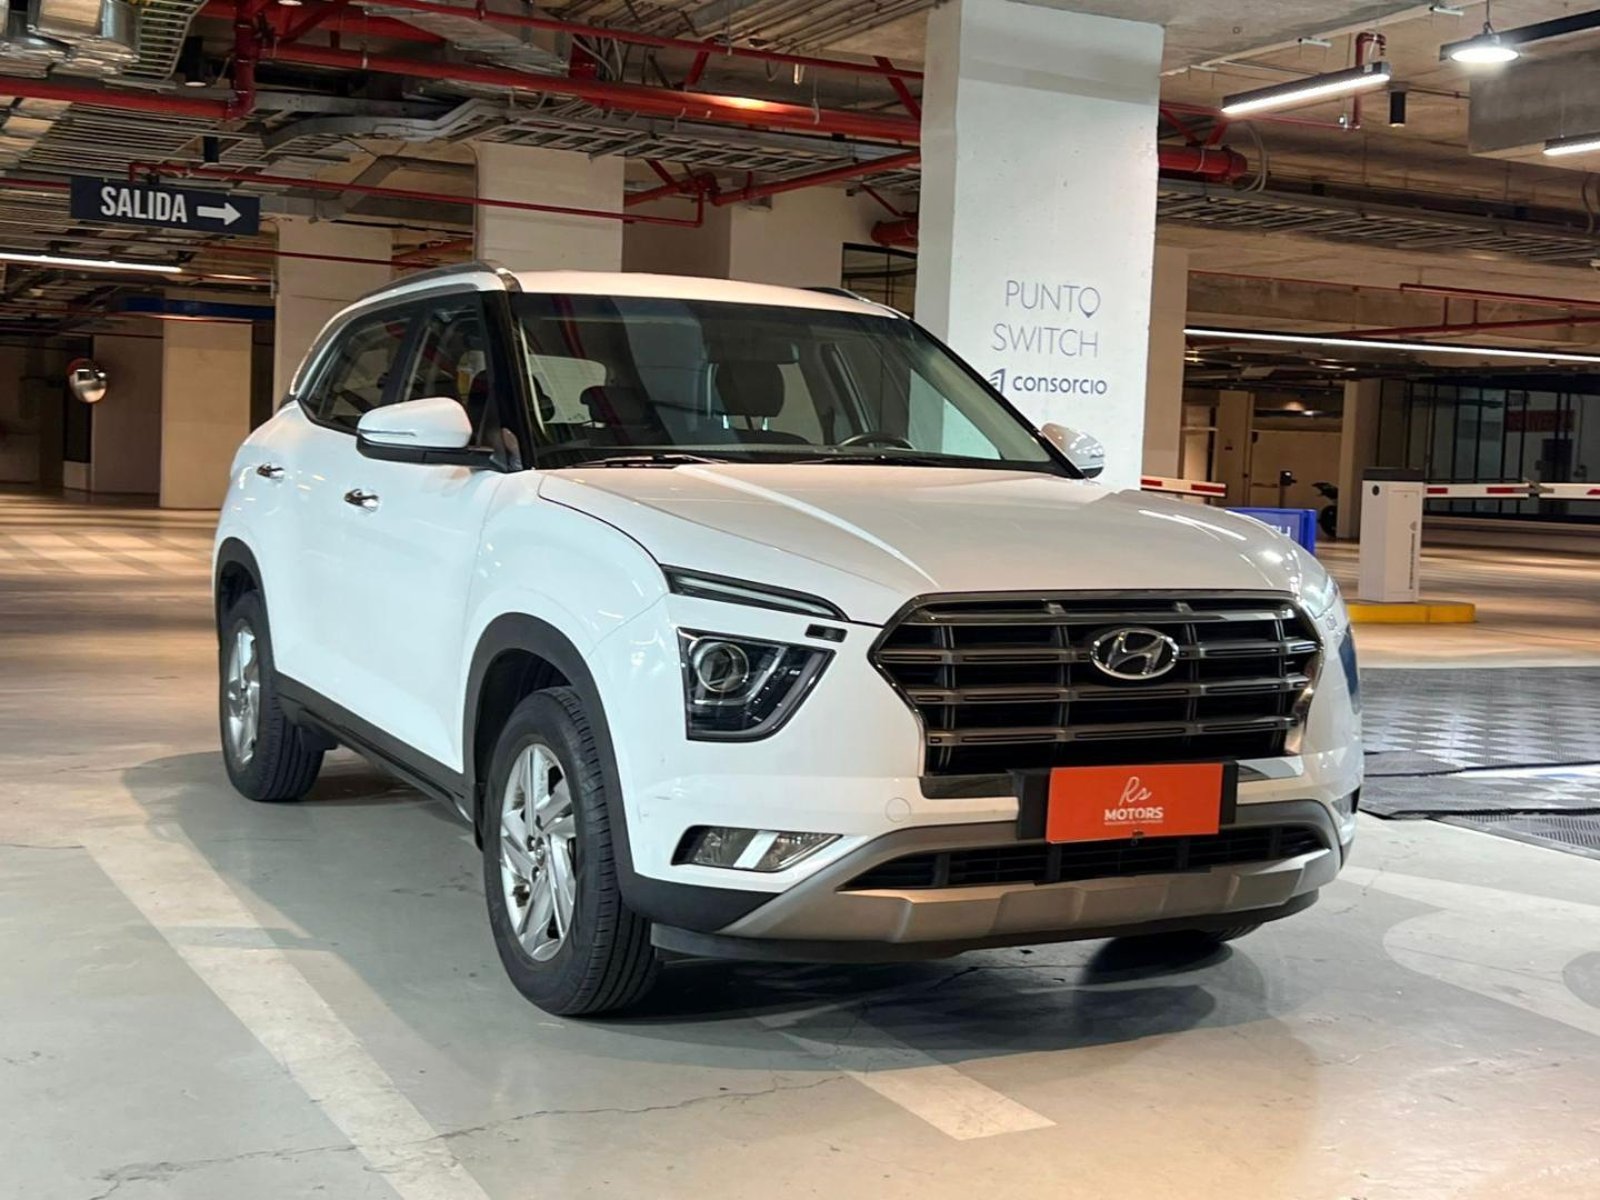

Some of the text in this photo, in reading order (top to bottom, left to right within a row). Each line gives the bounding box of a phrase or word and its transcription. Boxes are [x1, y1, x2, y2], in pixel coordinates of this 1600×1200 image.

[101, 186, 188, 223] SALIDA
[1005, 280, 1101, 318] PUNTO
[991, 323, 1098, 358] SWITCH
[1012, 375, 1107, 395] consorcio
[1104, 806, 1164, 821] MOTORS
